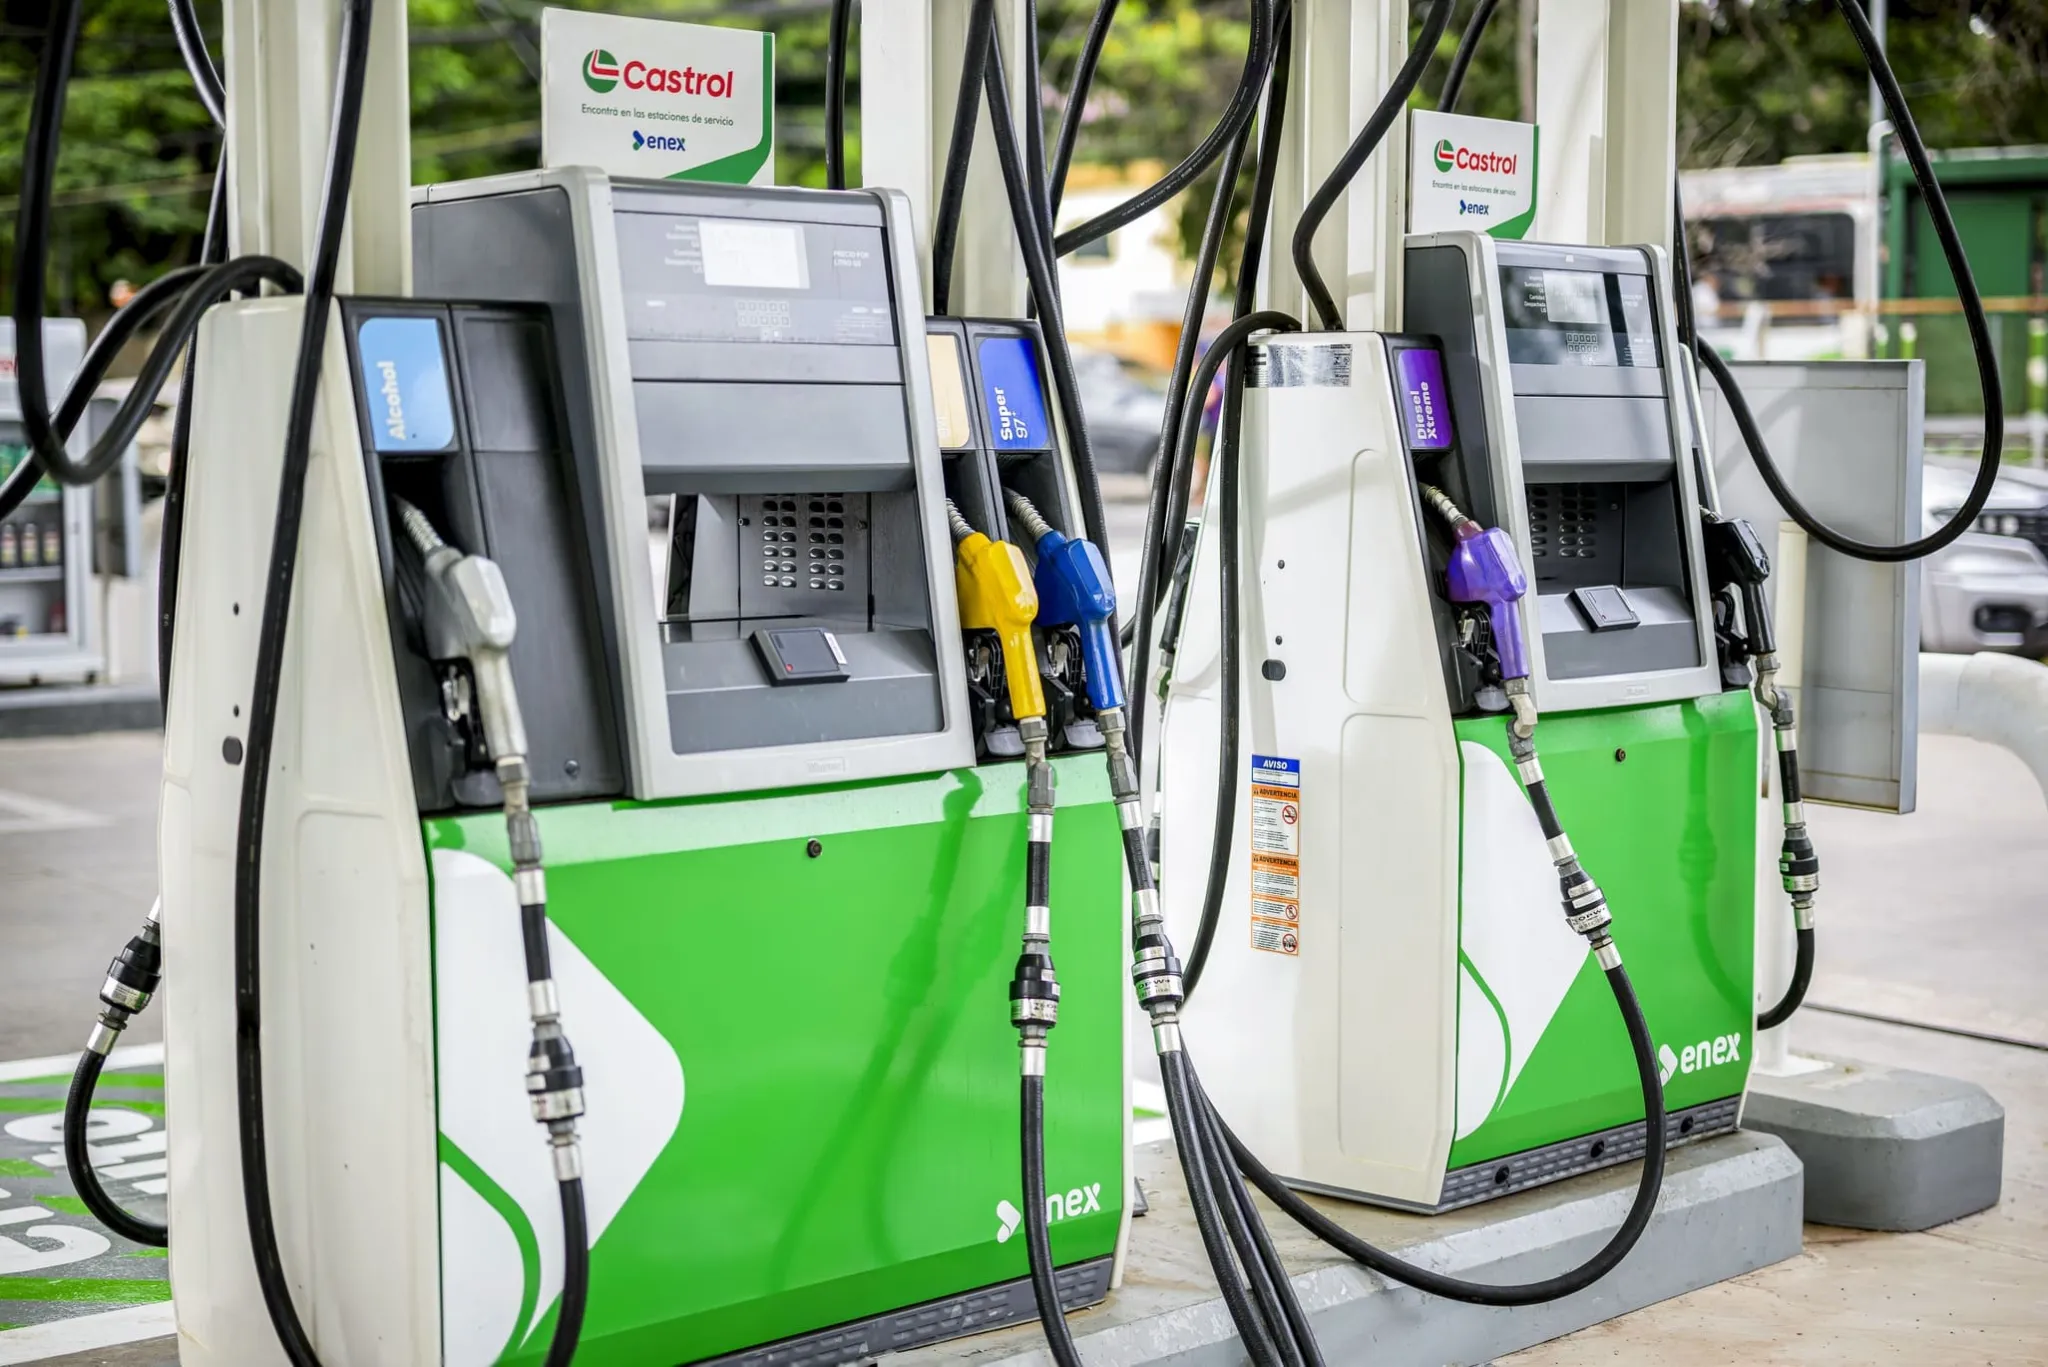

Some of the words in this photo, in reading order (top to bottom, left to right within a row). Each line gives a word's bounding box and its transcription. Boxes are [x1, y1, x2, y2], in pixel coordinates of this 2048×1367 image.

[623, 60, 734, 98] Castrol
[620, 109, 632, 118] en
[633, 108, 646, 119] las
[647, 111, 690, 123] estaciones
[691, 113, 703, 124] de
[703, 115, 734, 127] servicio
[647, 136, 686, 151] enex
[1456, 147, 1517, 175] Castrol
[1467, 203, 1489, 215] enex
[376, 361, 407, 440] Alcohol
[994, 386, 1013, 441] Super
[1410, 390, 1427, 440] Diesel
[1421, 381, 1438, 440] Xtreme
[1262, 759, 1288, 770] AVISO
[1260, 788, 1298, 799] ADVERTENCIA
[1259, 855, 1297, 866] ADVERTENCIA
[1680, 1032, 1741, 1074] enex
[1045, 1182, 1101, 1224] nex
